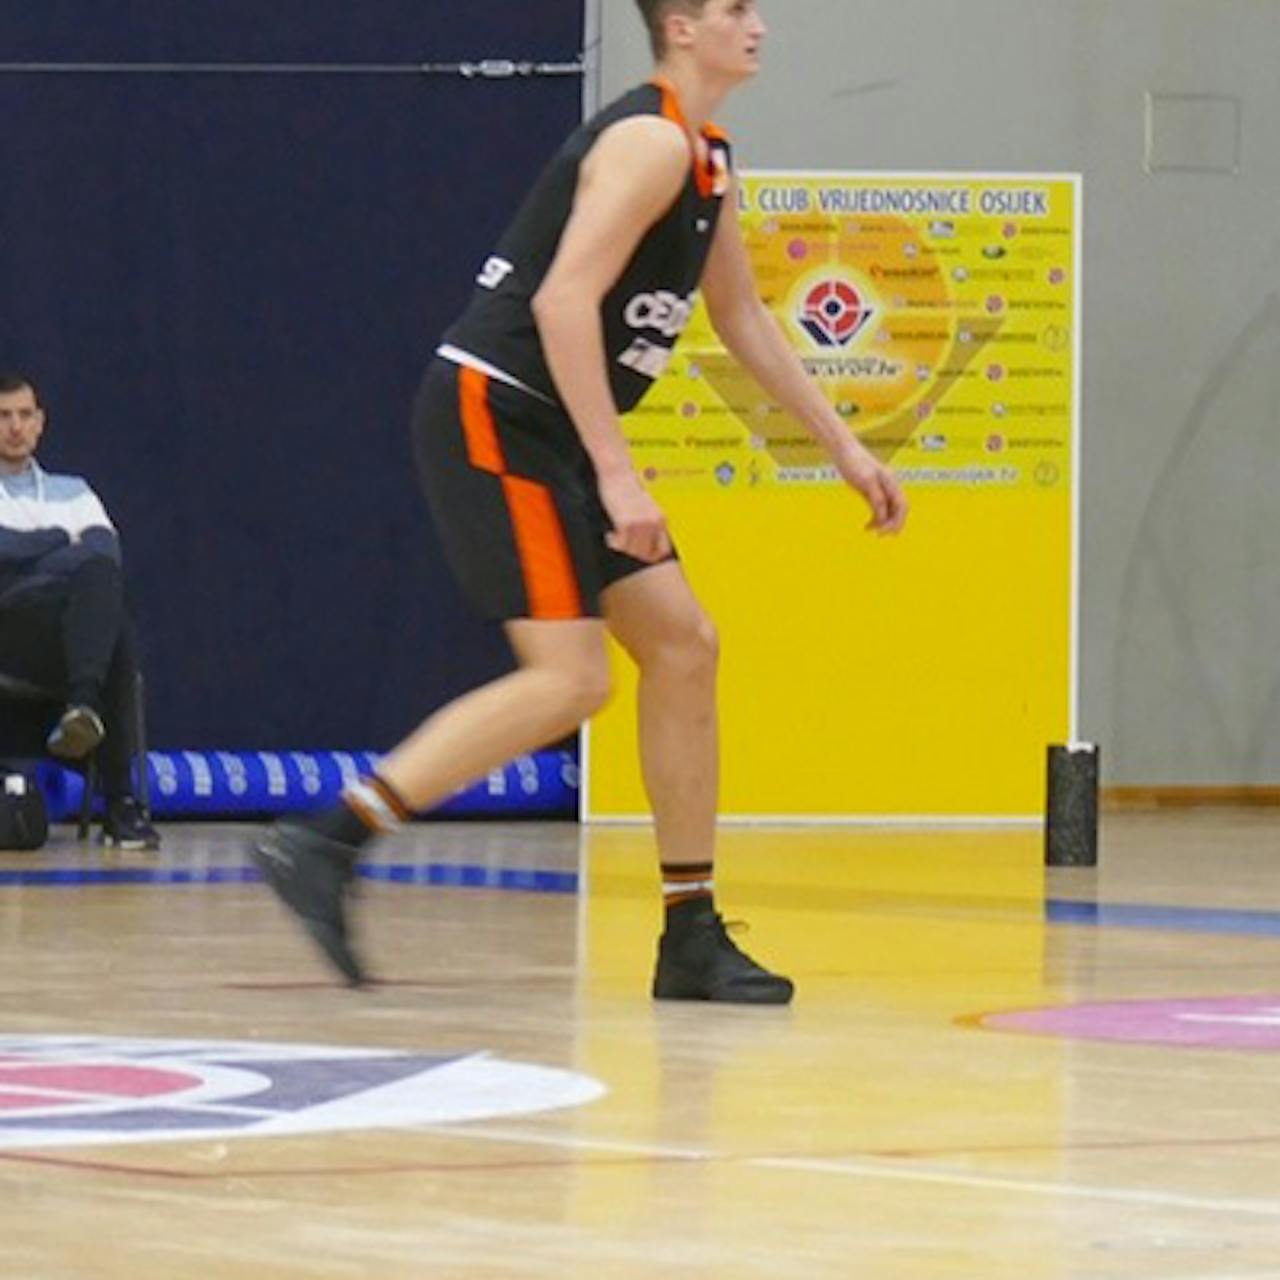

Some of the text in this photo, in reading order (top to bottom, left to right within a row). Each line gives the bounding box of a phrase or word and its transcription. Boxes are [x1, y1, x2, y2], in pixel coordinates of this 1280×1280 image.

[758, 189, 809, 212] CLUB
[819, 189, 969, 213] VRIJEDNOSNICE
[980, 190, 1047, 214] OSIJEK
